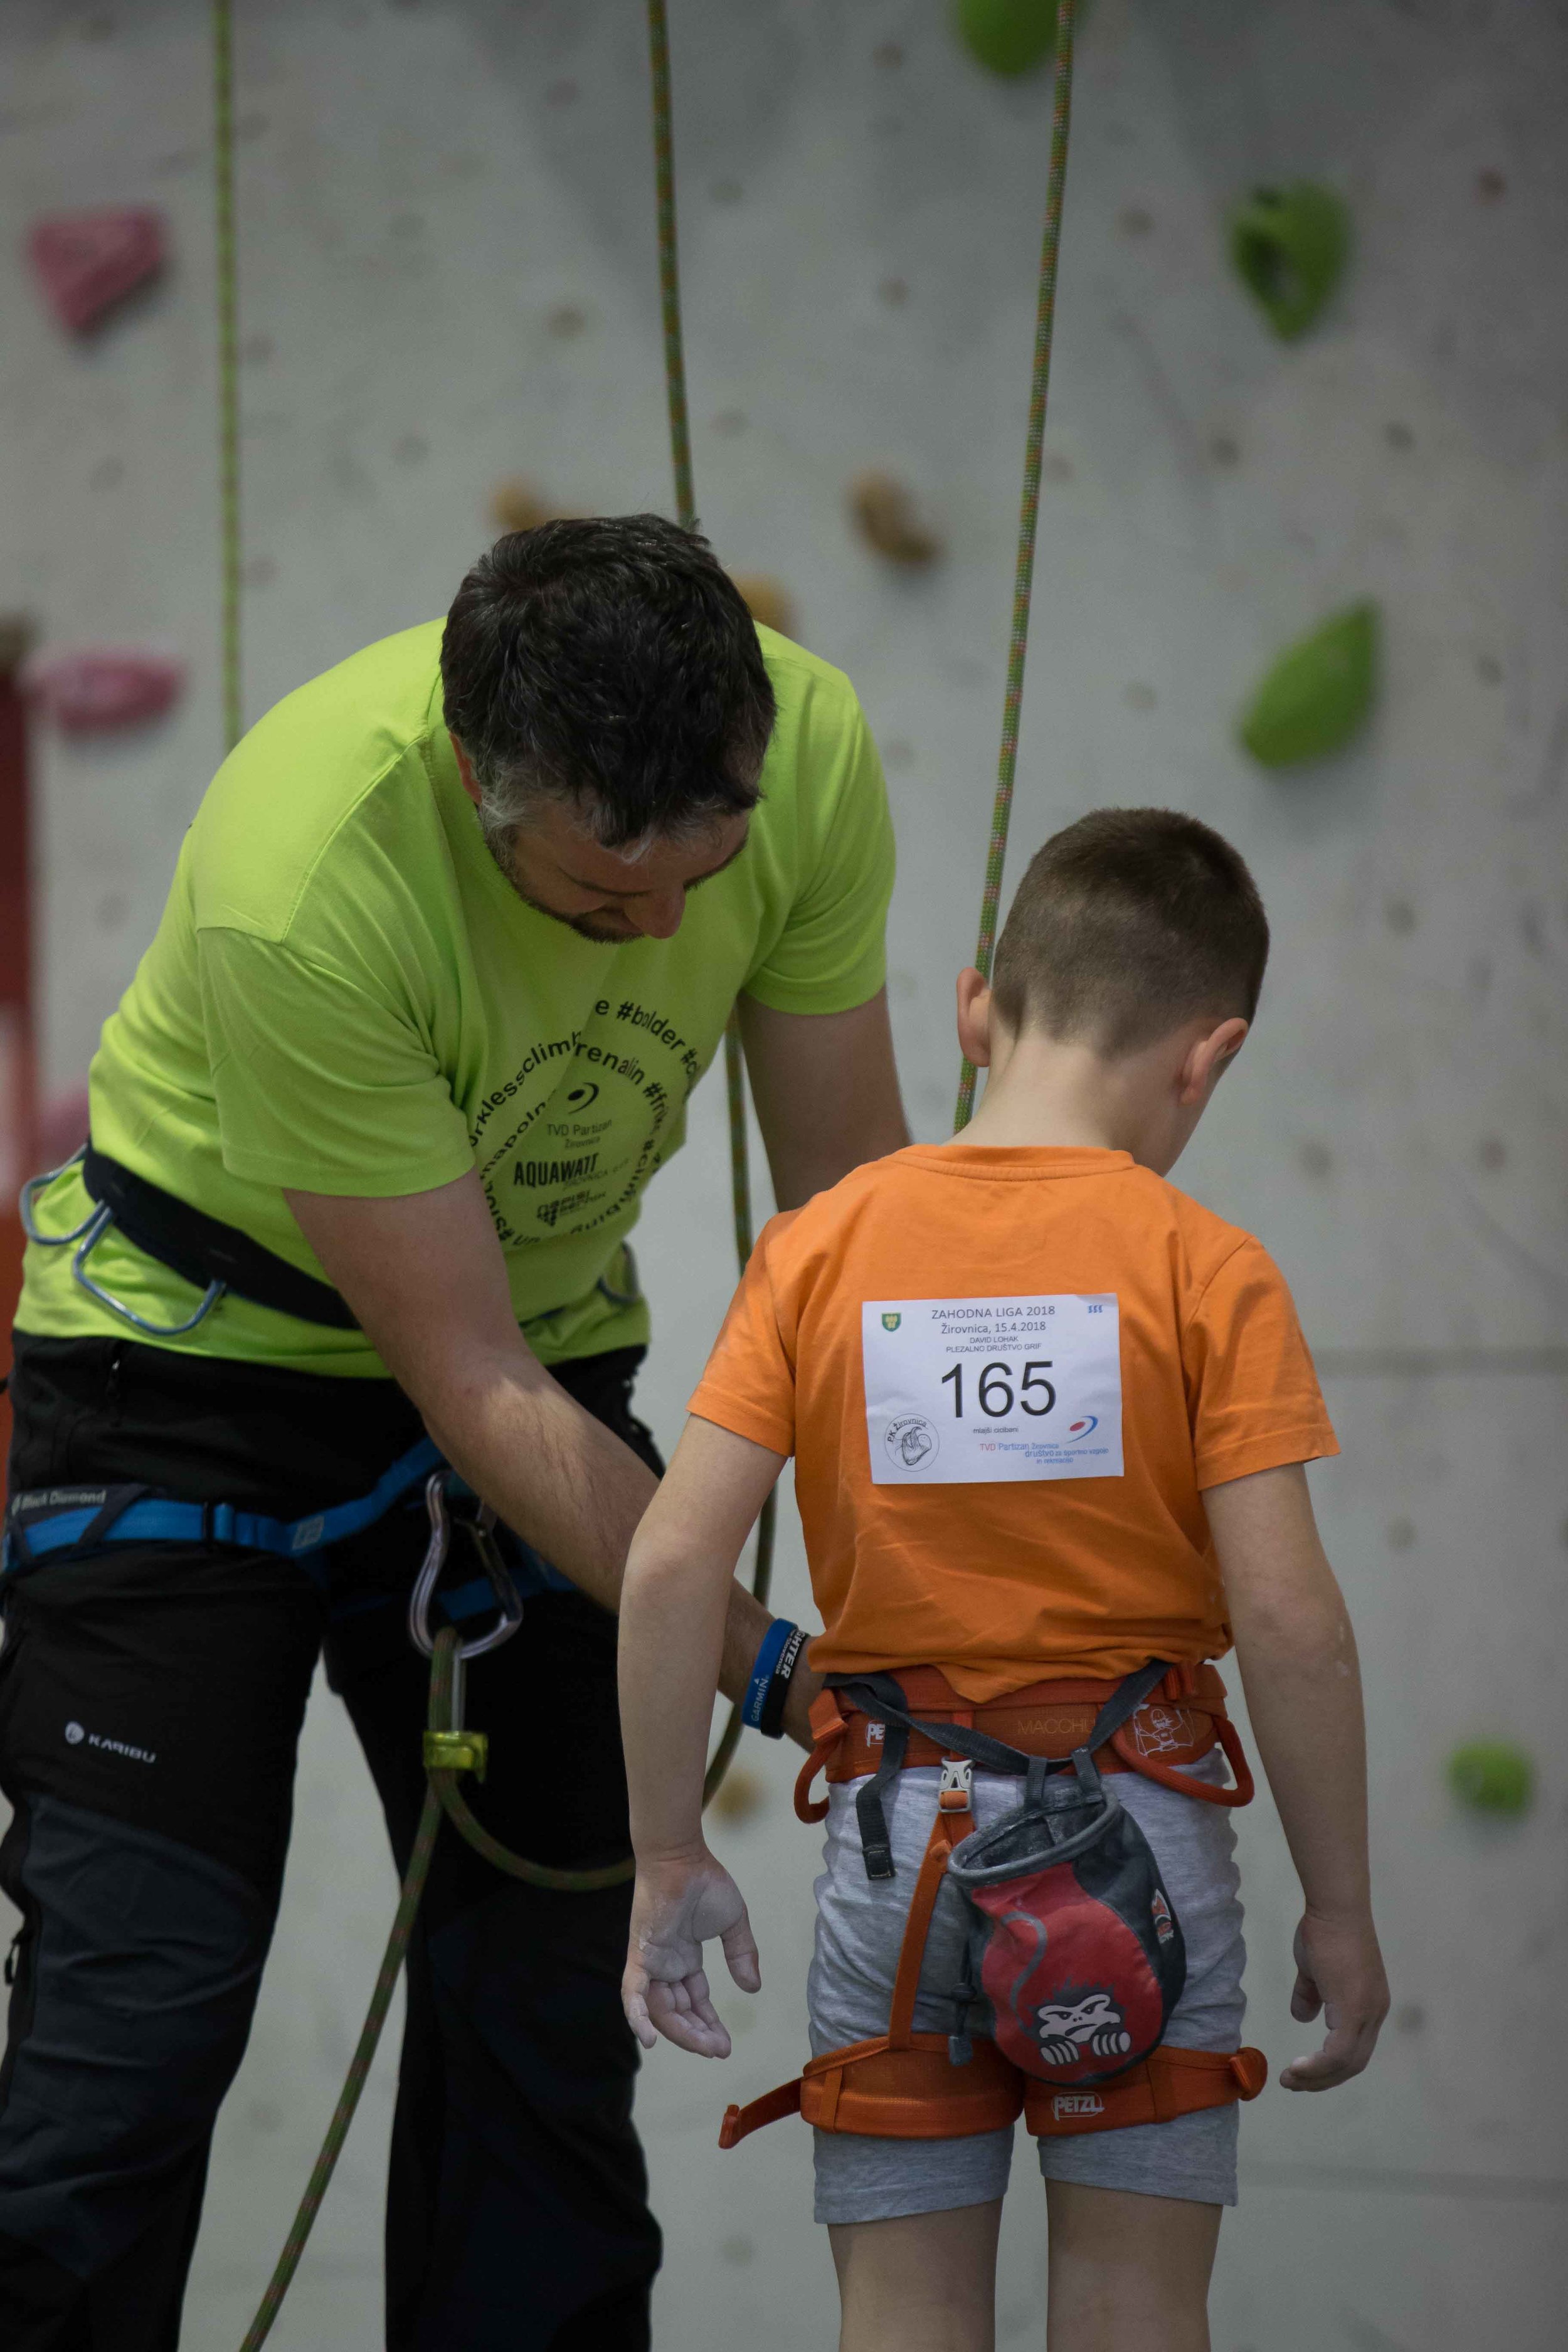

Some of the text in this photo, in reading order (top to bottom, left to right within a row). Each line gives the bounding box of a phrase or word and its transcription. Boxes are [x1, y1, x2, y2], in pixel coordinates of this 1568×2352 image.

[575, 1042, 645, 1085] renalin
[547, 1120, 612, 1136] TVD Partizan
[513, 1152, 599, 1188] AQUAWATT
[931, 1305, 1056, 1320] ZAHODNA LIGA 2018
[941, 1321, 1046, 1335] Žirovnica, 15.4.2018
[987, 1343, 1023, 1352] DRUŠTVO
[941, 1360, 1056, 1418] 165
[887, 1418, 928, 1443] PK Žirovnica
[980, 1443, 995, 1451] TVD
[998, 1443, 1030, 1451] Partizan
[780, 1631, 805, 1679] GHTER
[751, 1677, 769, 1722] GARMIN
[88, 1733, 157, 1764] KARIBU
[1053, 2094, 1105, 2121] PETZL
